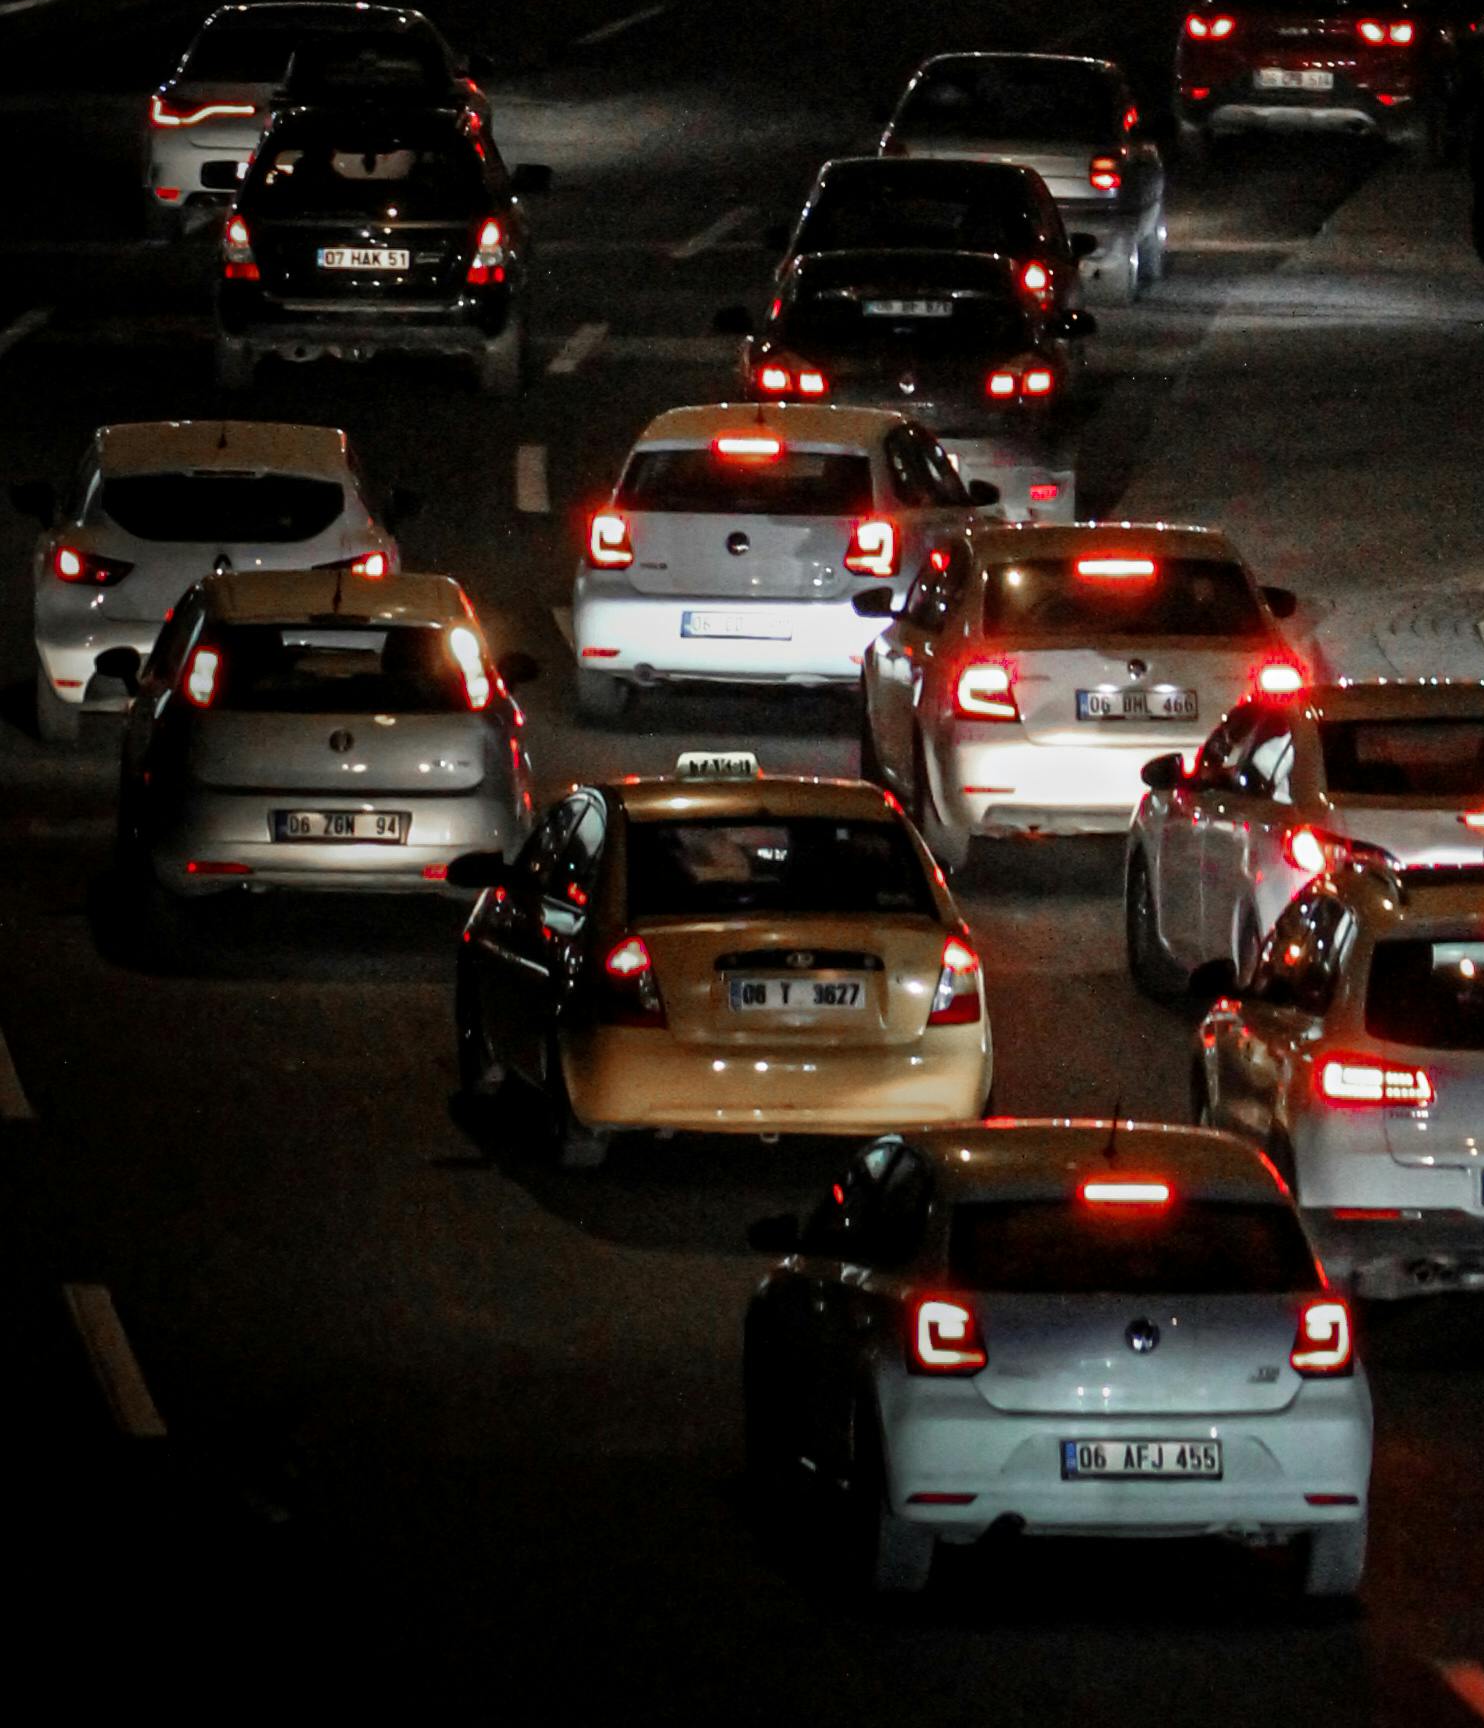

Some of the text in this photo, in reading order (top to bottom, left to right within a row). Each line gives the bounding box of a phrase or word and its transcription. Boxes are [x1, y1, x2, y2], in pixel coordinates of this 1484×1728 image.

[325, 250, 344, 266] 07
[351, 250, 381, 267] HAK
[388, 251, 406, 267] 51
[1089, 694, 1111, 715] 06
[1162, 695, 1194, 714] 466
[289, 813, 311, 834] 06
[375, 815, 396, 835] 94
[742, 984, 766, 1005] 06
[780, 982, 791, 1005] T
[1079, 1443, 1216, 1470] 06 AFJ 455
